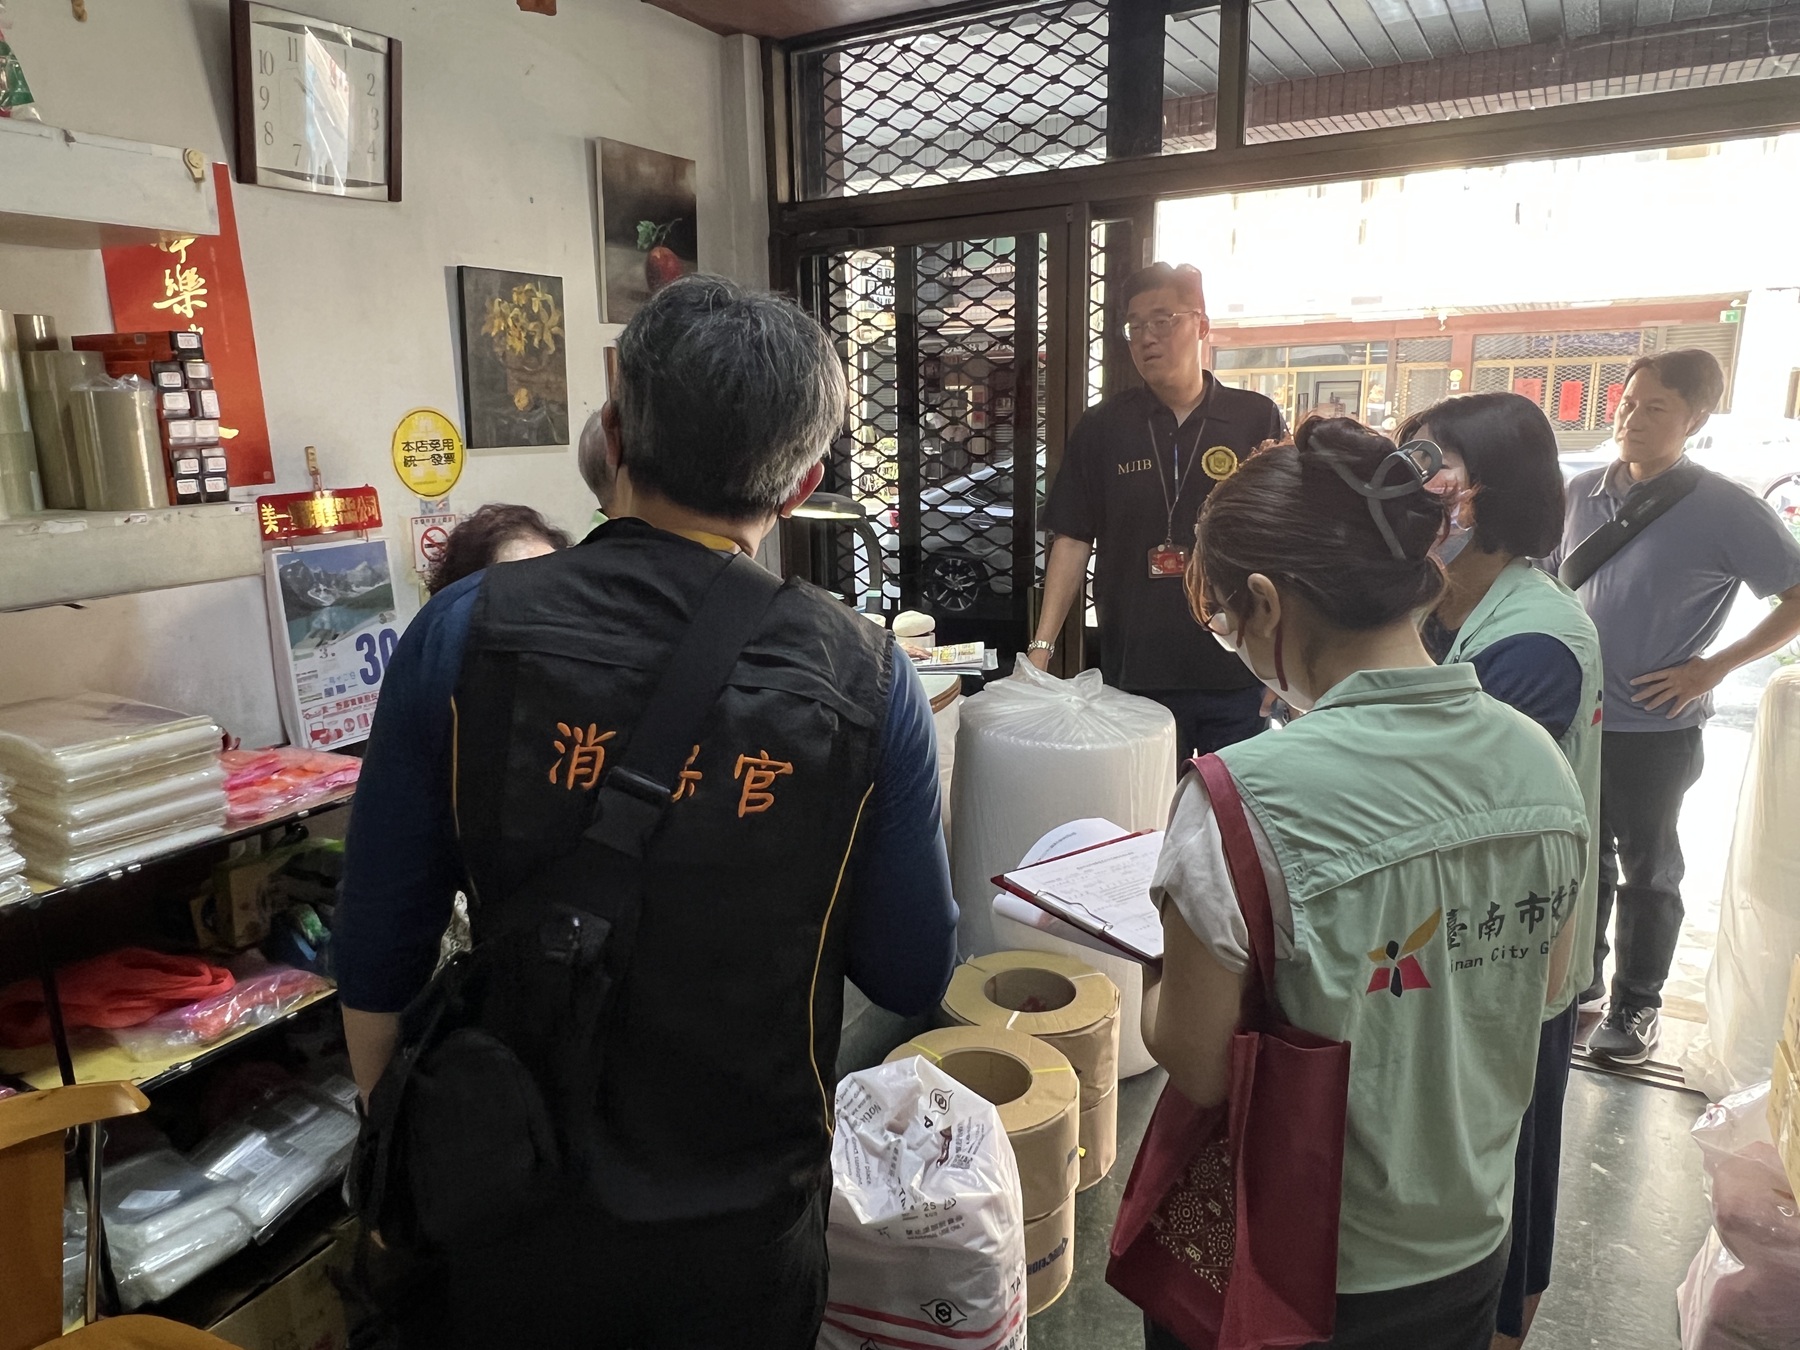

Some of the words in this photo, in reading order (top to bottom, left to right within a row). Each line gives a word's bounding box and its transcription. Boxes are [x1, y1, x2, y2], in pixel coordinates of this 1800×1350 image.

[259, 49, 275, 76] 10
[366, 73, 376, 97] 2
[259, 86, 270, 110] 9
[370, 107, 379, 131] 3
[264, 121, 274, 146] 8
[292, 143, 302, 167] 7
[401, 438, 455, 453] 本店免用
[403, 453, 456, 467] 統一發票
[1117, 458, 1152, 475] MJIB
[355, 628, 398, 685] 30
[549, 721, 794, 818] 消官
[1446, 878, 1578, 950] 臺南市
[1450, 957, 1483, 973] inan
[1491, 944, 1529, 962] City
